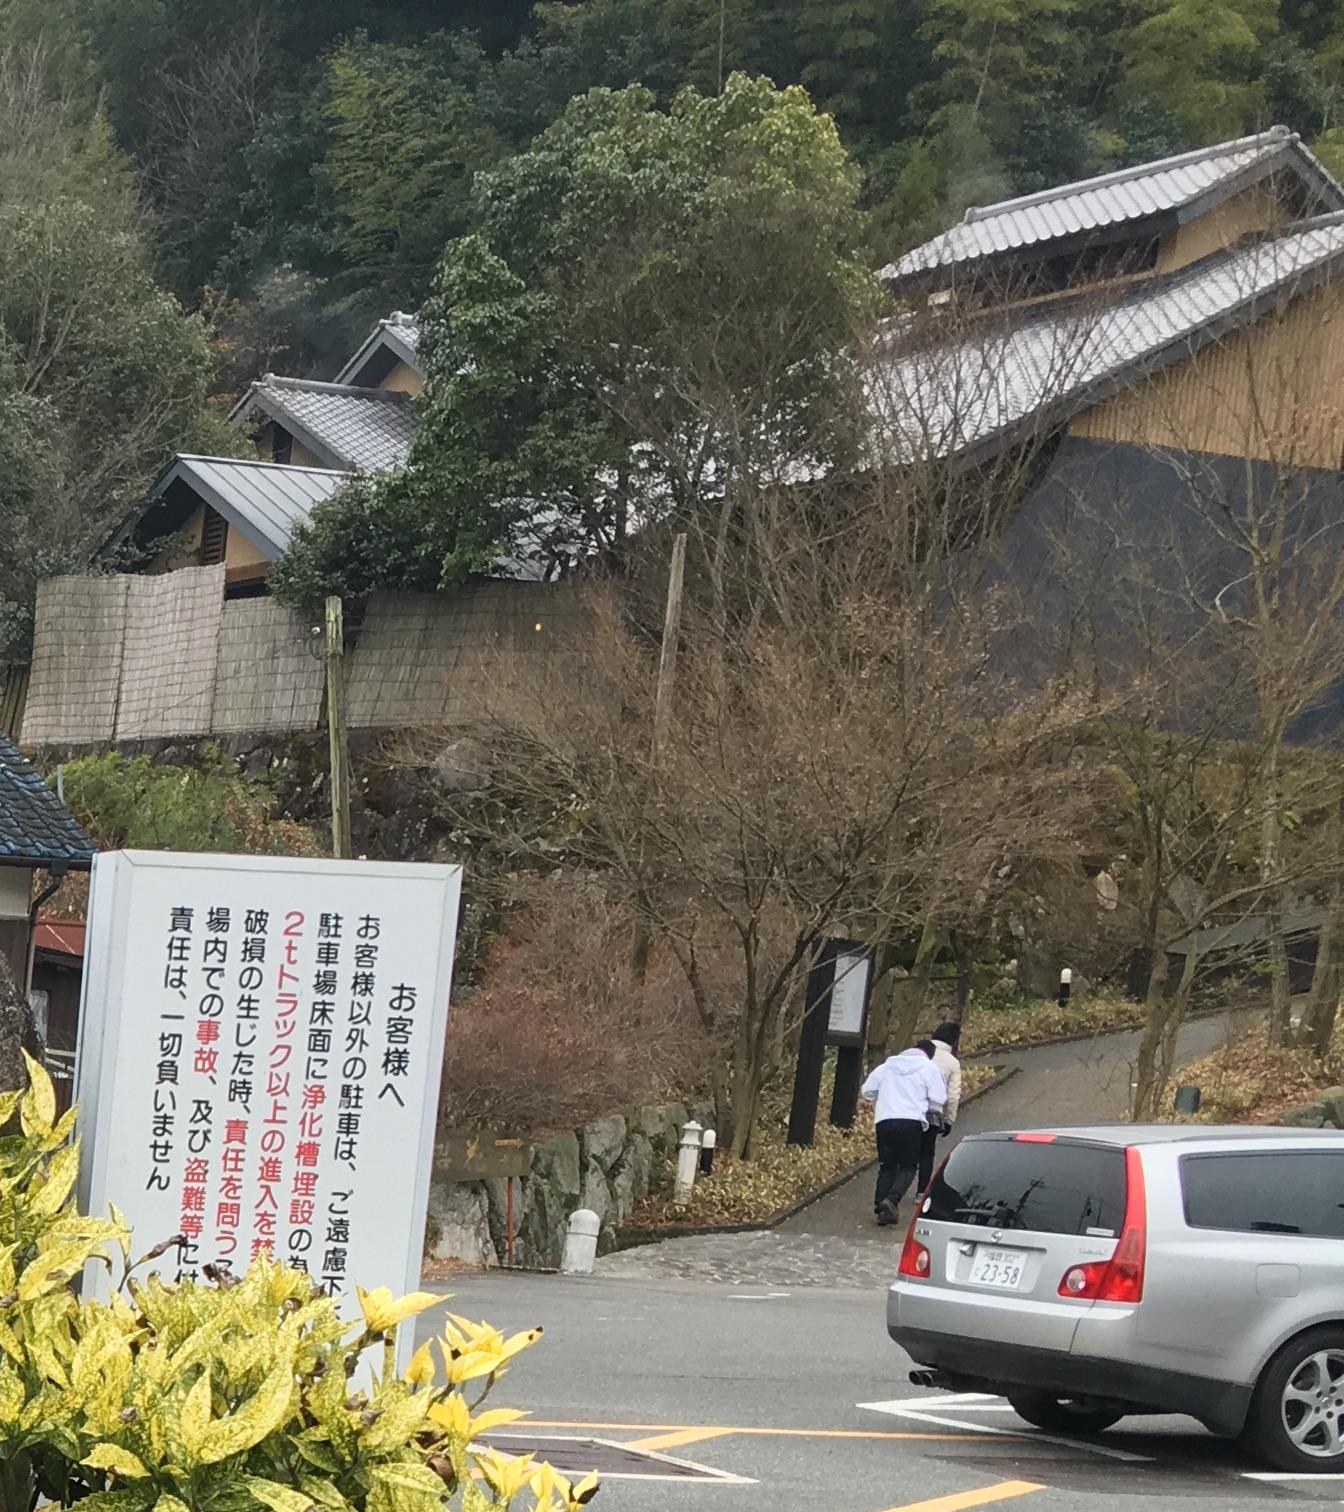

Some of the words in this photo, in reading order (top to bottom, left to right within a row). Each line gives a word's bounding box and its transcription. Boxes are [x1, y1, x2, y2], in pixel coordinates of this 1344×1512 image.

[146, 905, 194, 1192] 責任は、一切負いません
[379, 982, 417, 1108] お客様へ
